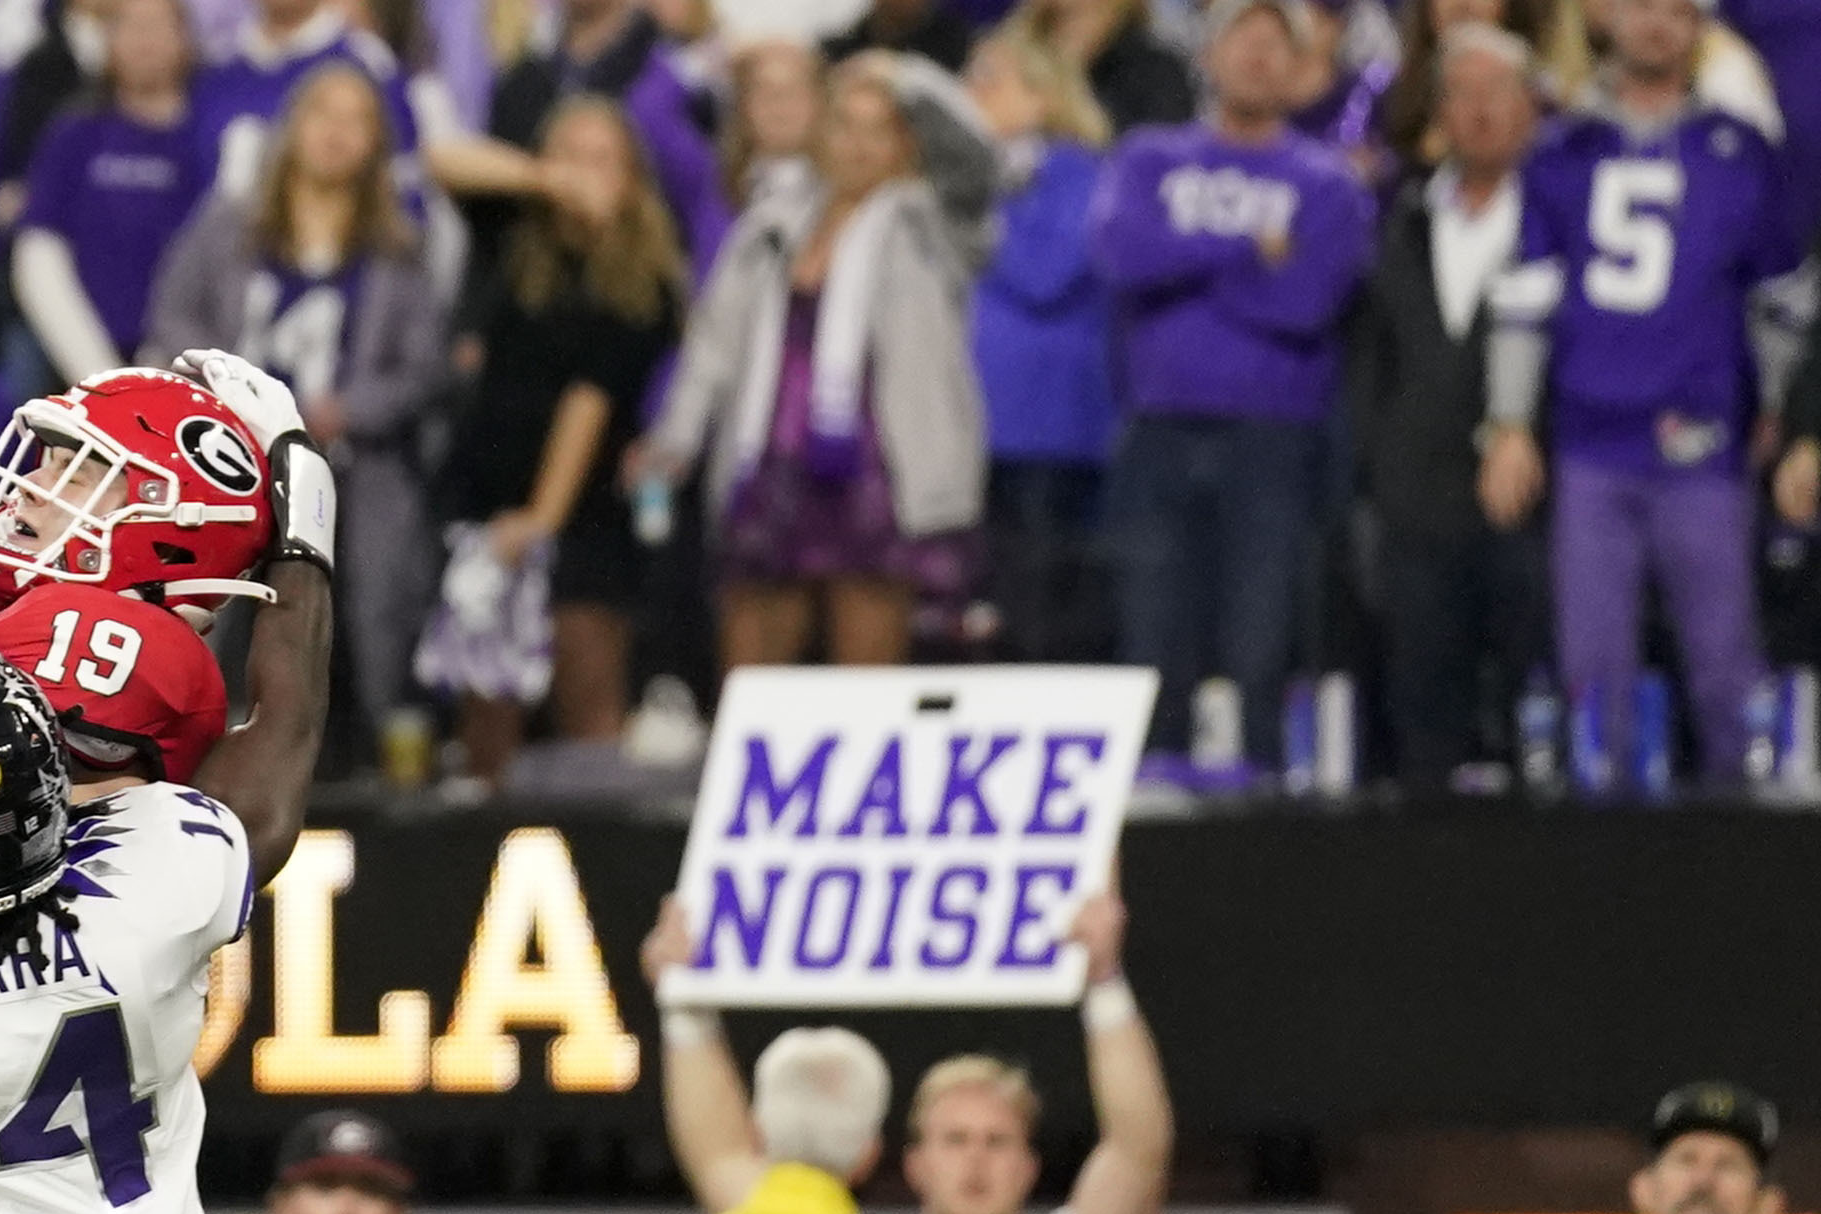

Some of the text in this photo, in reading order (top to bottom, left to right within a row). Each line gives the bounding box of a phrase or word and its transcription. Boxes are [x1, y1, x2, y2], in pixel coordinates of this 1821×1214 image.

[1583, 160, 1687, 315] 5
[33, 608, 143, 697] 19
[723, 734, 1108, 838] MAKE
[691, 865, 1078, 970] NOISE
